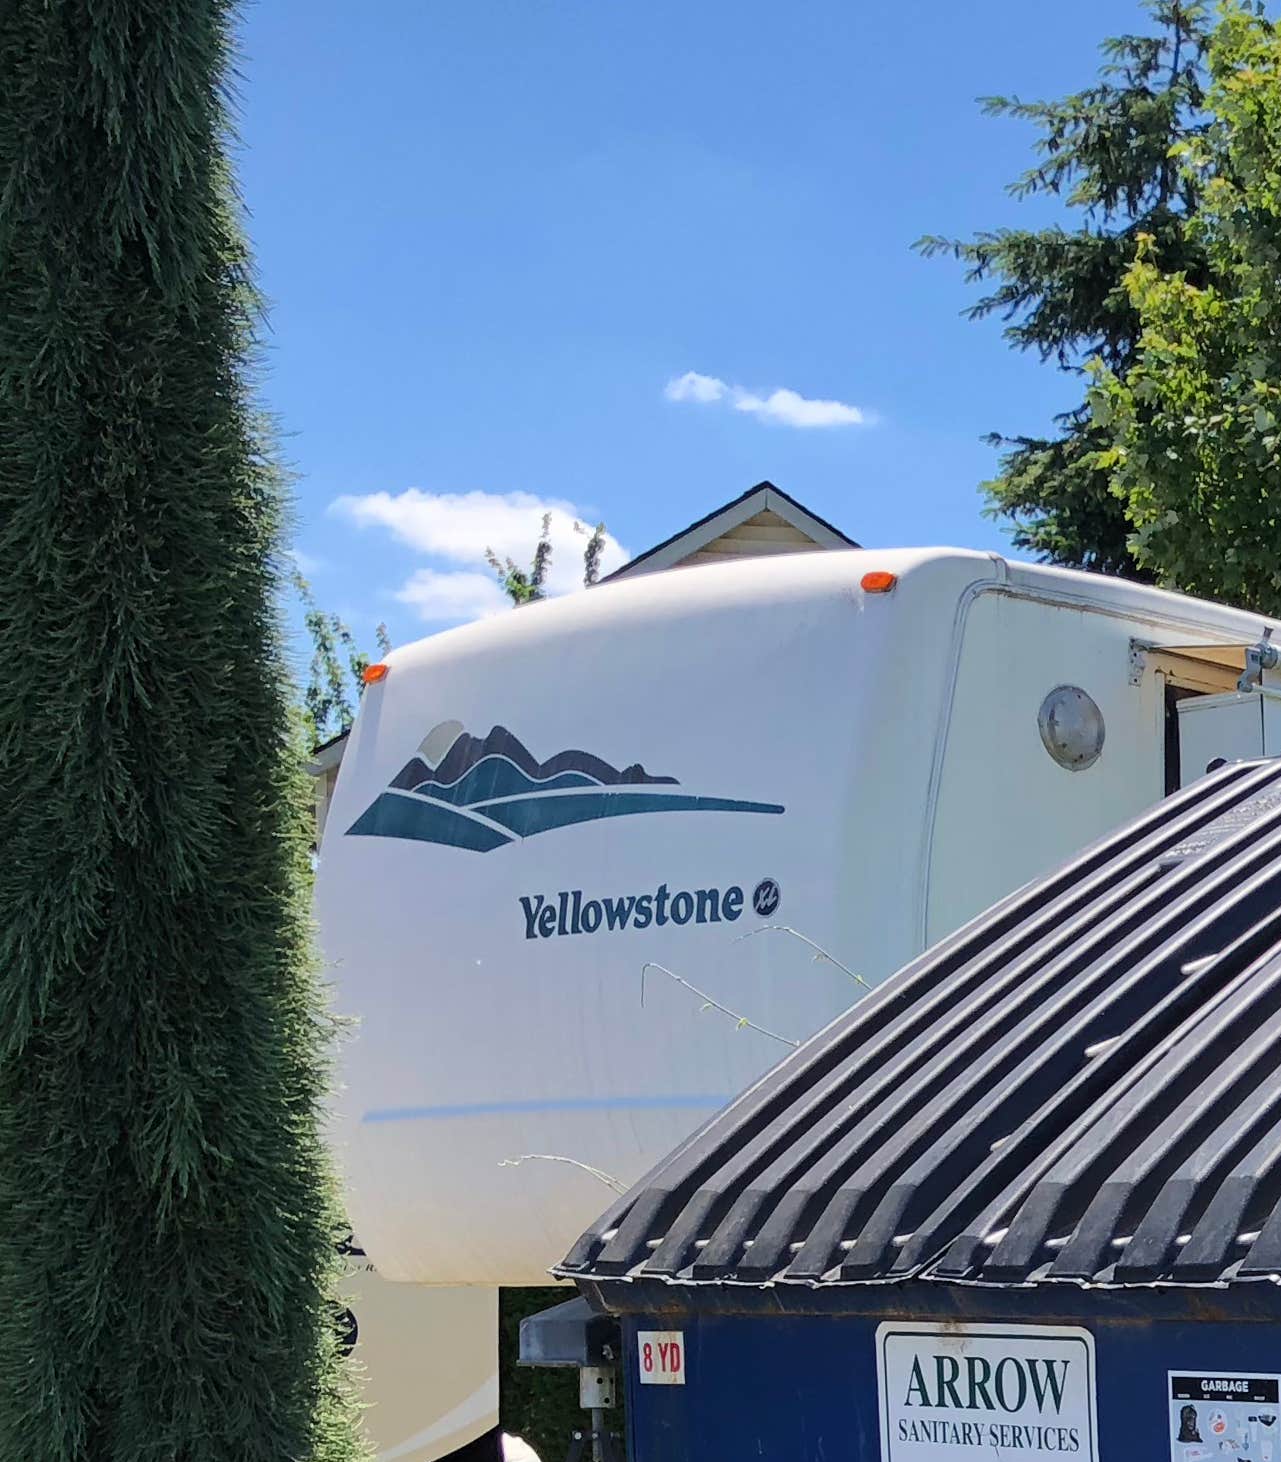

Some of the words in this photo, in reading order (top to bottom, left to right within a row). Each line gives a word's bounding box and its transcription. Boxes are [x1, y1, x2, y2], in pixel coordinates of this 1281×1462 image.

[519, 883, 744, 939] Yellowstone
[643, 1343, 653, 1372] 8
[657, 1342, 681, 1372] YD
[904, 1353, 1071, 1415] ARROW
[1200, 1379, 1249, 1393] GARBAGE
[899, 1418, 985, 1447] SANITARY
[989, 1423, 1080, 1452] SERVICES
